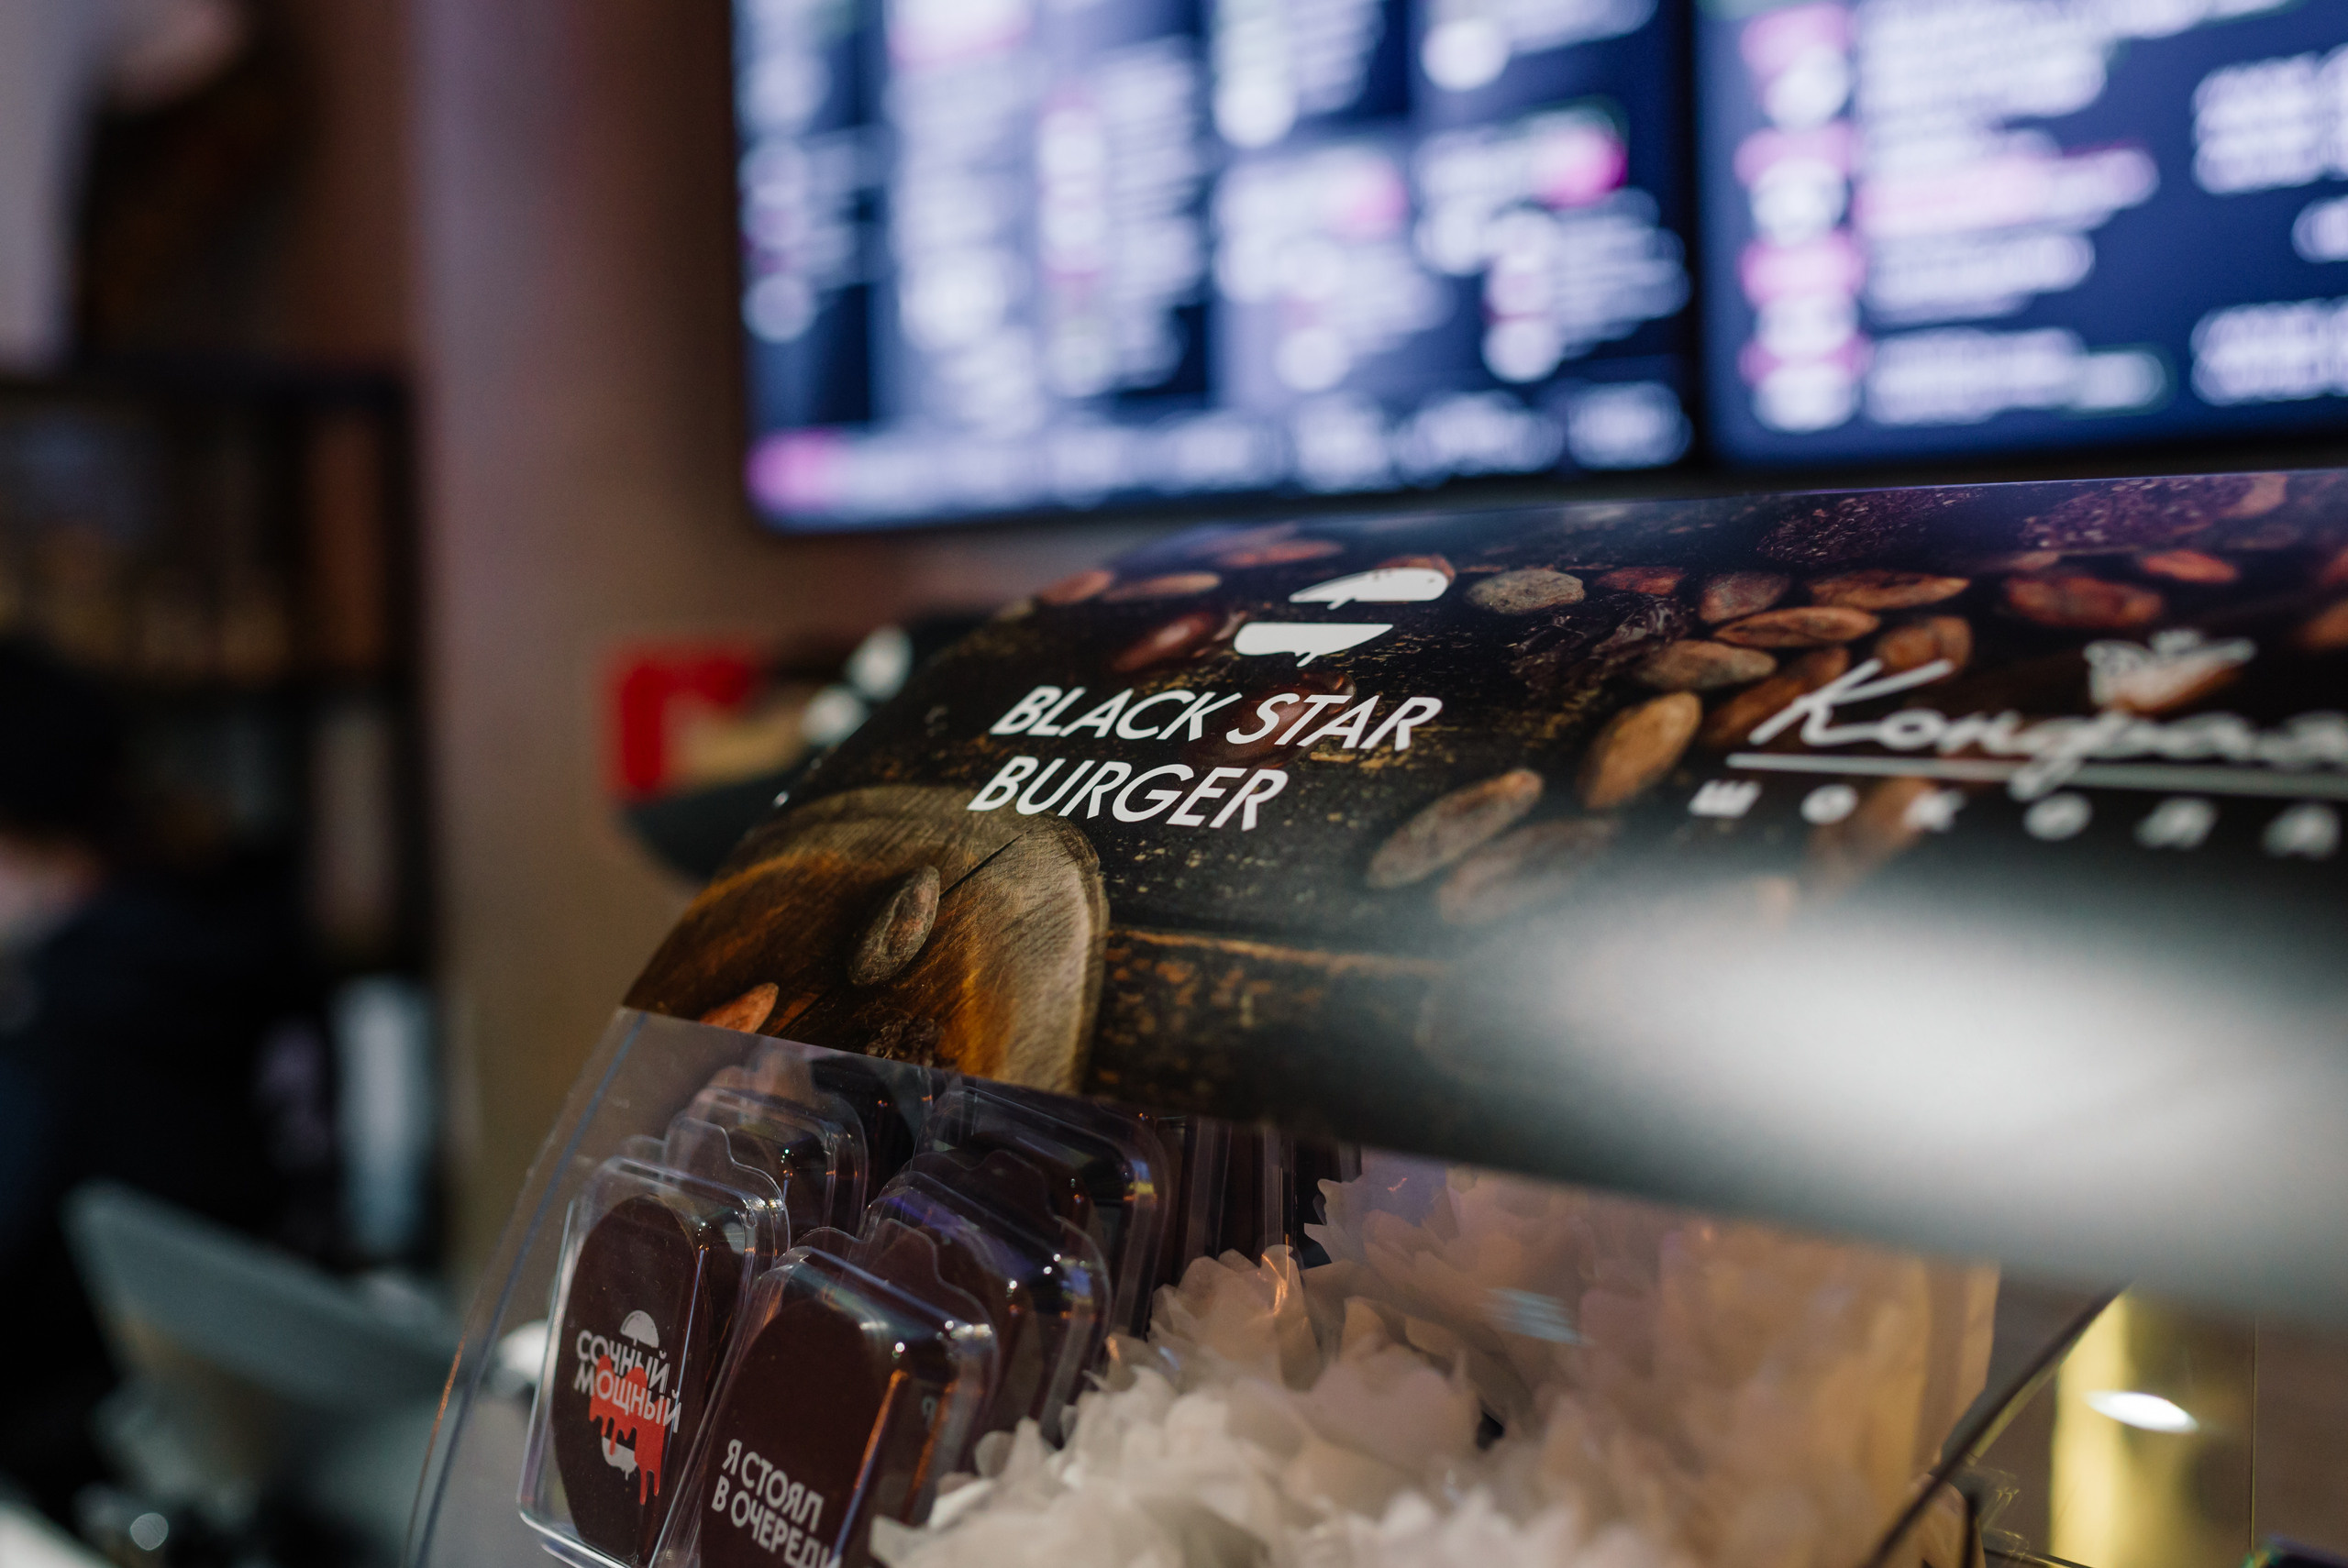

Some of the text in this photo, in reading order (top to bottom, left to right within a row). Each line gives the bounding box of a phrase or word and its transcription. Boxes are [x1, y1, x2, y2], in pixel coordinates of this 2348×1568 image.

[990, 685, 1443, 752] BLACK STAR
[966, 756, 1289, 832] BURGER
[576, 1330, 670, 1394] СОЧНЫЙ
[573, 1361, 682, 1434] МОЩНЫЙ
[711, 1474, 731, 1513] В
[722, 1438, 825, 1533] Я СТОЯЛ
